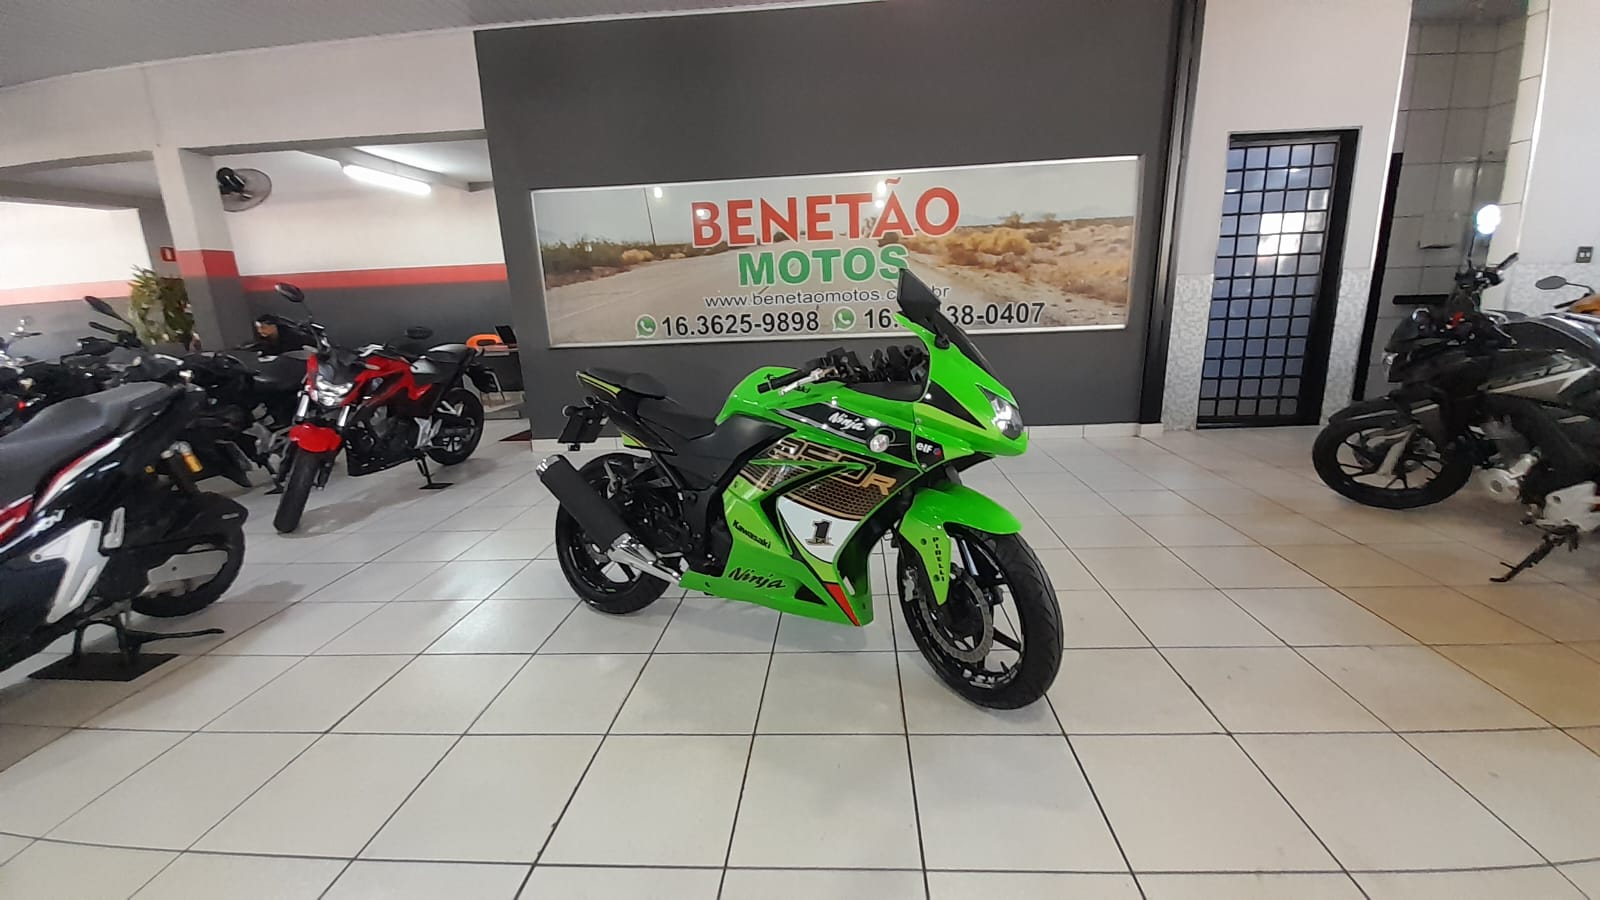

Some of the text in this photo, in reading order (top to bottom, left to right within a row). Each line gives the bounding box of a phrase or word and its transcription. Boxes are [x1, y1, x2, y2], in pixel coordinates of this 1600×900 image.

[691, 177, 960, 247] BENETÃO
[738, 245, 909, 286] MOTOS
[705, 285, 950, 307] www.benetaomotos.cbr
[662, 310, 820, 337] 16.3625-9898
[828, 411, 866, 431] Ninja
[916, 442, 933, 454] elf
[733, 519, 771, 549] Kawasaki
[728, 567, 786, 589] Ninja
